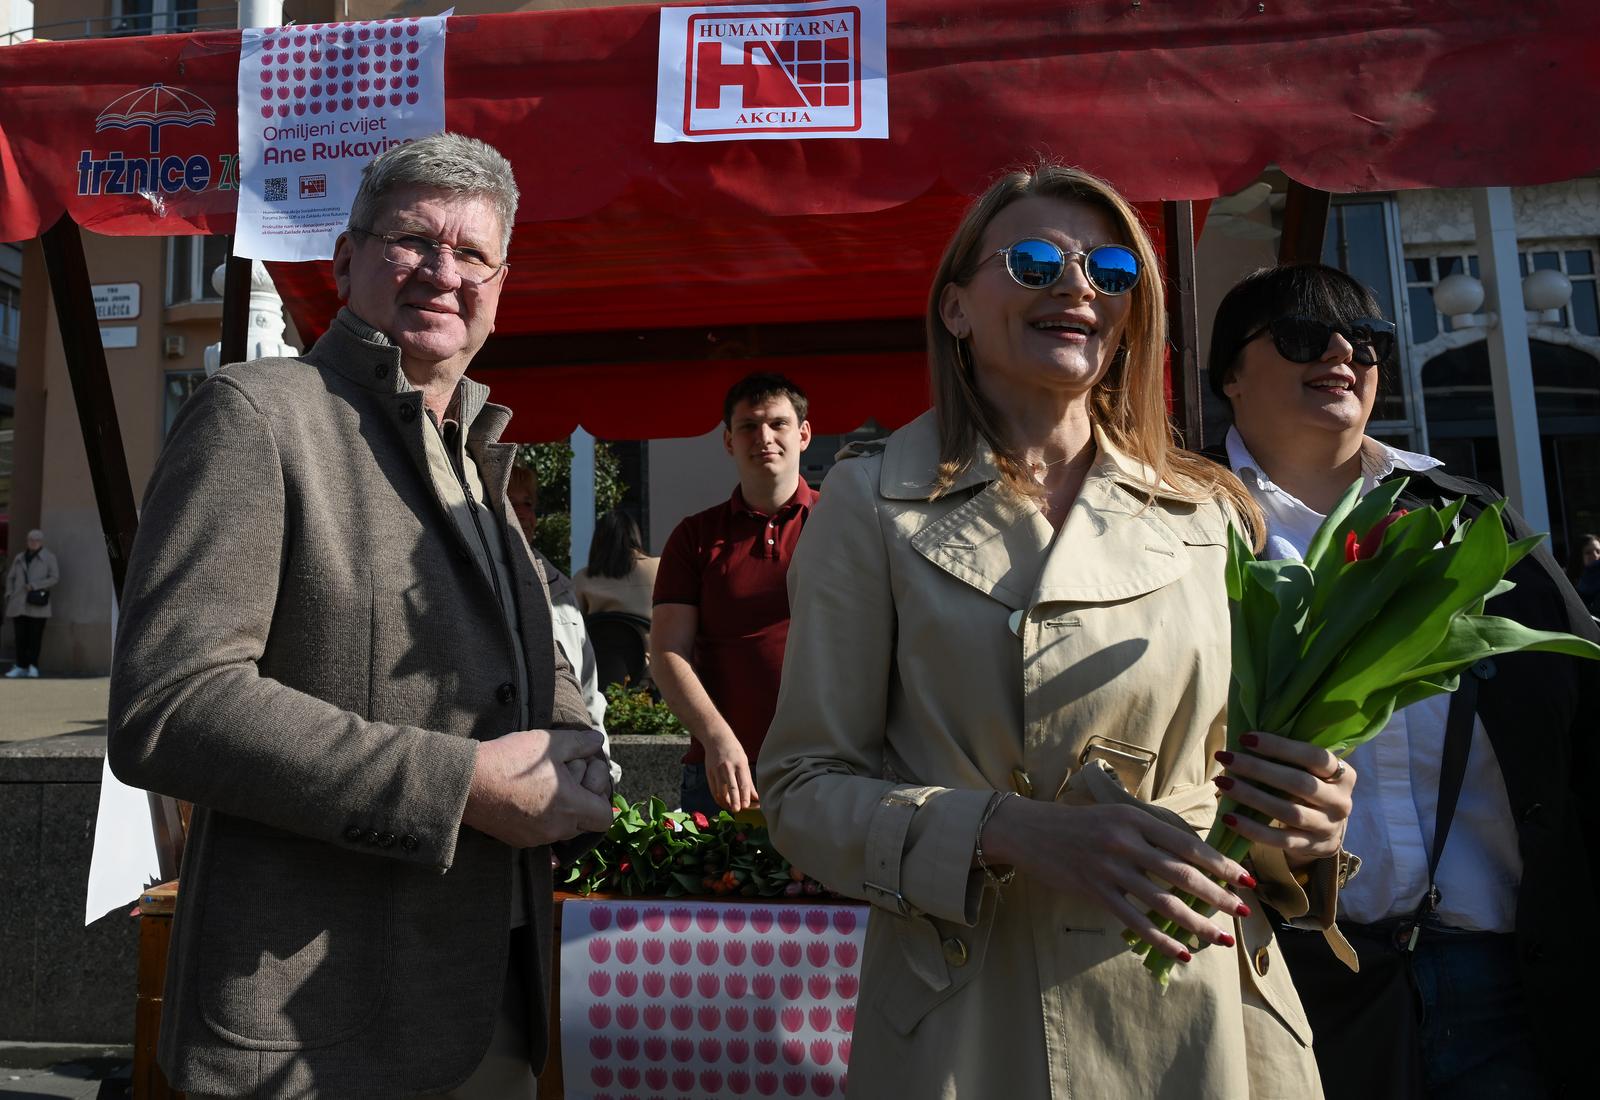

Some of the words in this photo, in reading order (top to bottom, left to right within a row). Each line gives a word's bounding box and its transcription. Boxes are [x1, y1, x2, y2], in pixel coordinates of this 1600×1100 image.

[700, 19, 849, 37] HUMANITARNA
[263, 120, 335, 141] Omiljeni
[339, 116, 387, 135] cvijet
[736, 111, 812, 124] AKCIJA
[263, 147, 306, 165] Ane
[312, 136, 414, 161] Rukavin
[77, 150, 211, 195] tržnice
